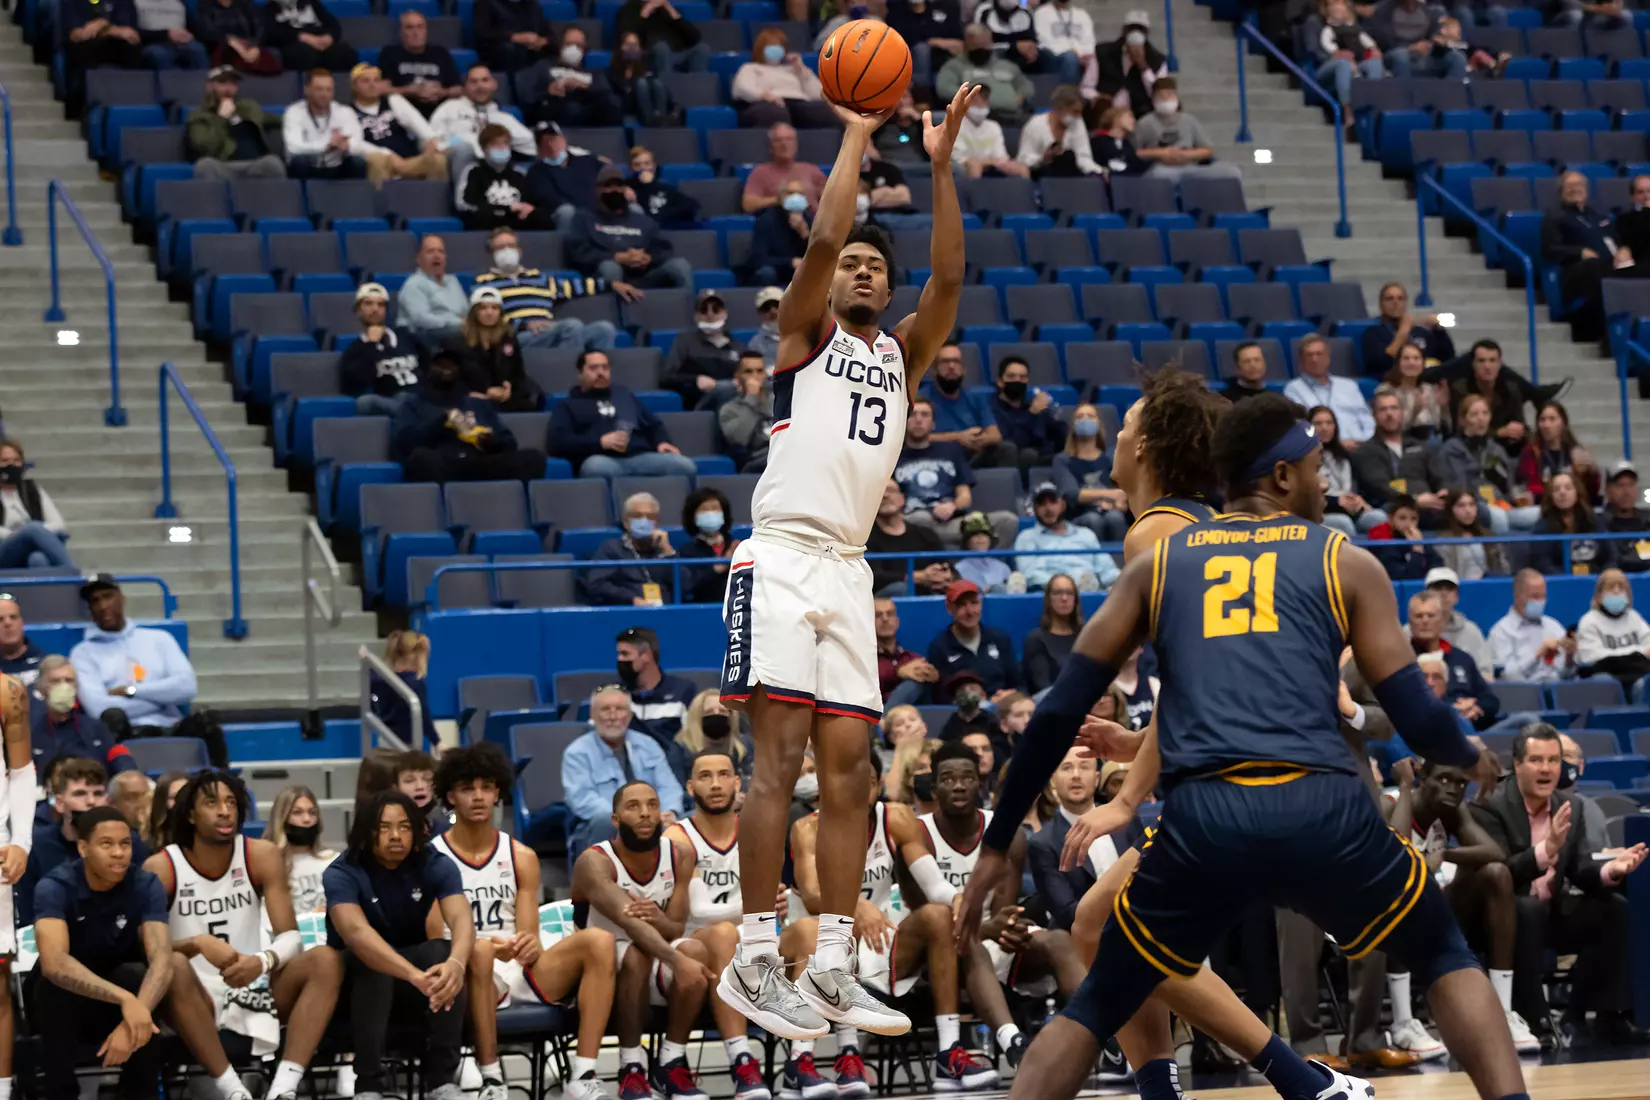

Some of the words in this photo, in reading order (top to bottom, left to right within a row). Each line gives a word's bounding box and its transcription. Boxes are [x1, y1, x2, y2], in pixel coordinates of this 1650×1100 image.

[848, 391, 887, 446] 13
[728, 576, 744, 683] HUSKIES
[1203, 551, 1279, 639] 21
[178, 890, 253, 917] UCONN
